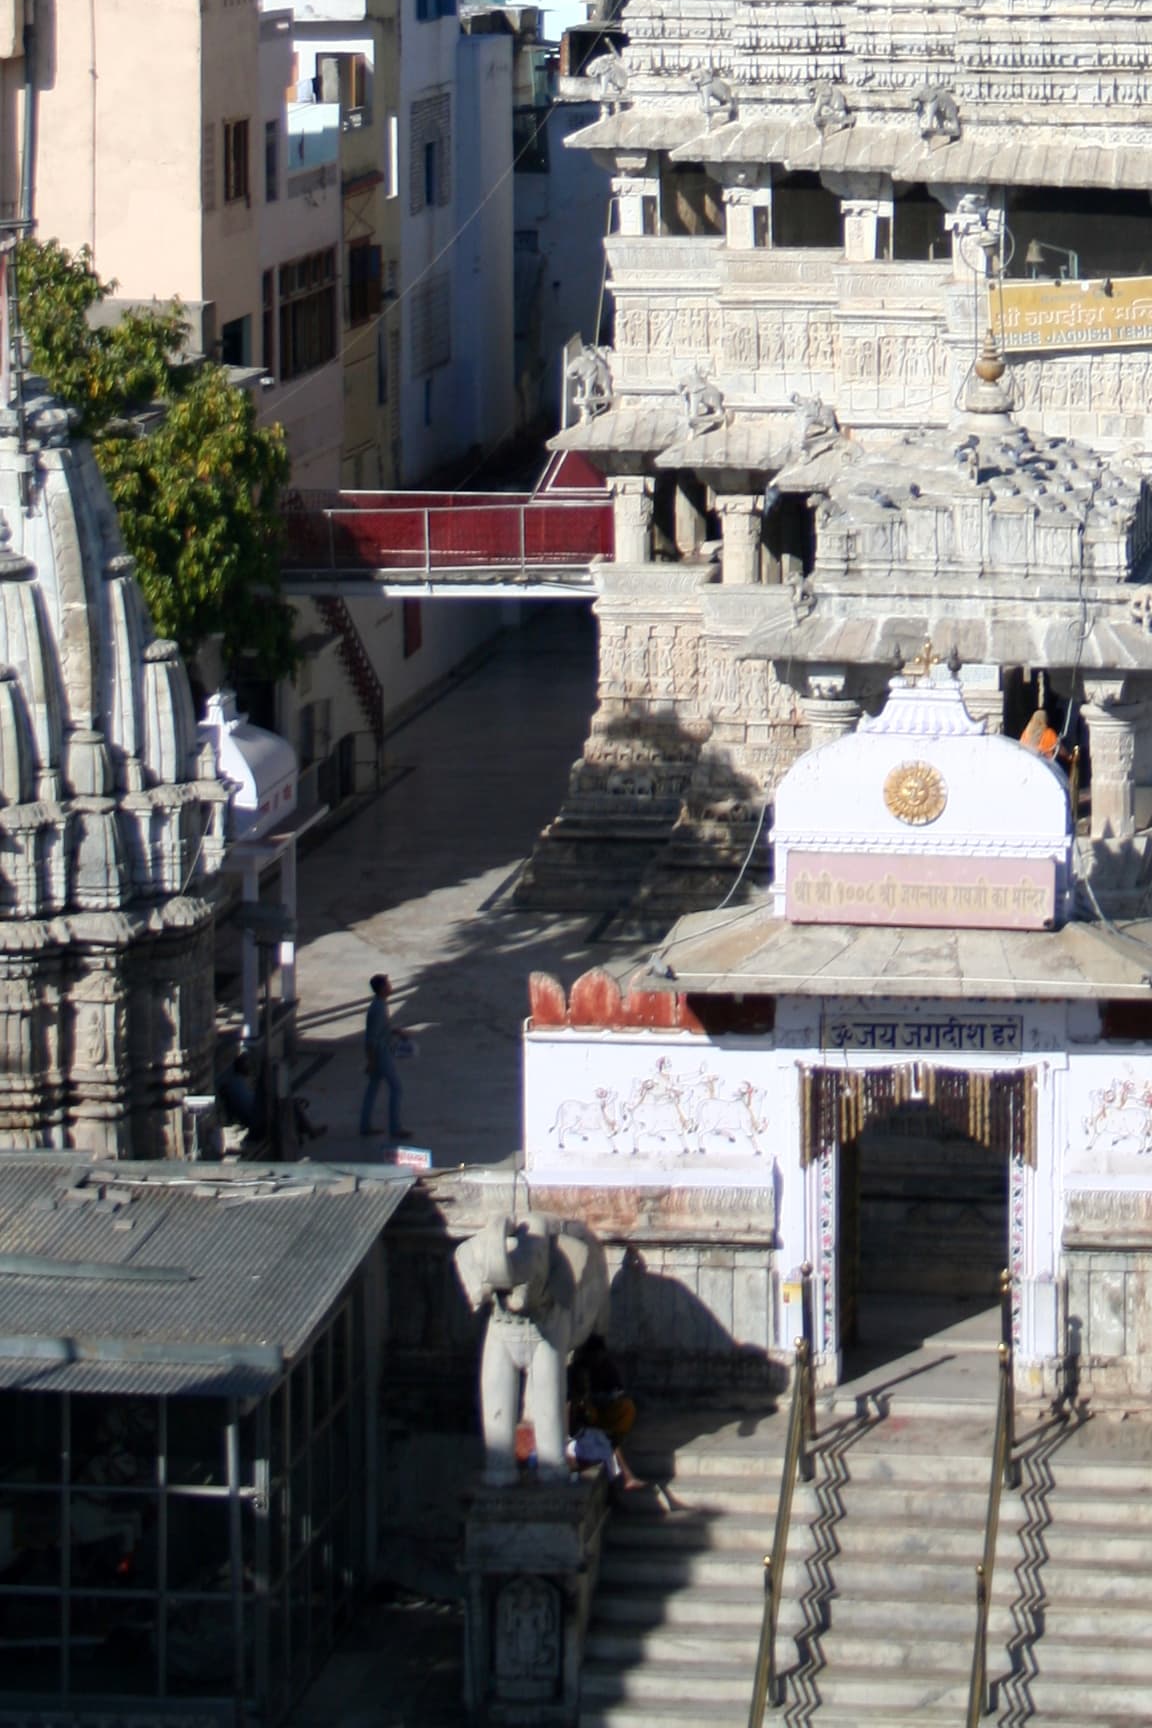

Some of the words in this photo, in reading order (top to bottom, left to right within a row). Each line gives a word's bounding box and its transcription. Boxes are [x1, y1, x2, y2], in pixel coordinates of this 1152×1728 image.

[992, 330, 1042, 347] SHREE
[1046, 327, 1112, 344] JAGDISH
[903, 1017, 987, 1049] जगदीश
